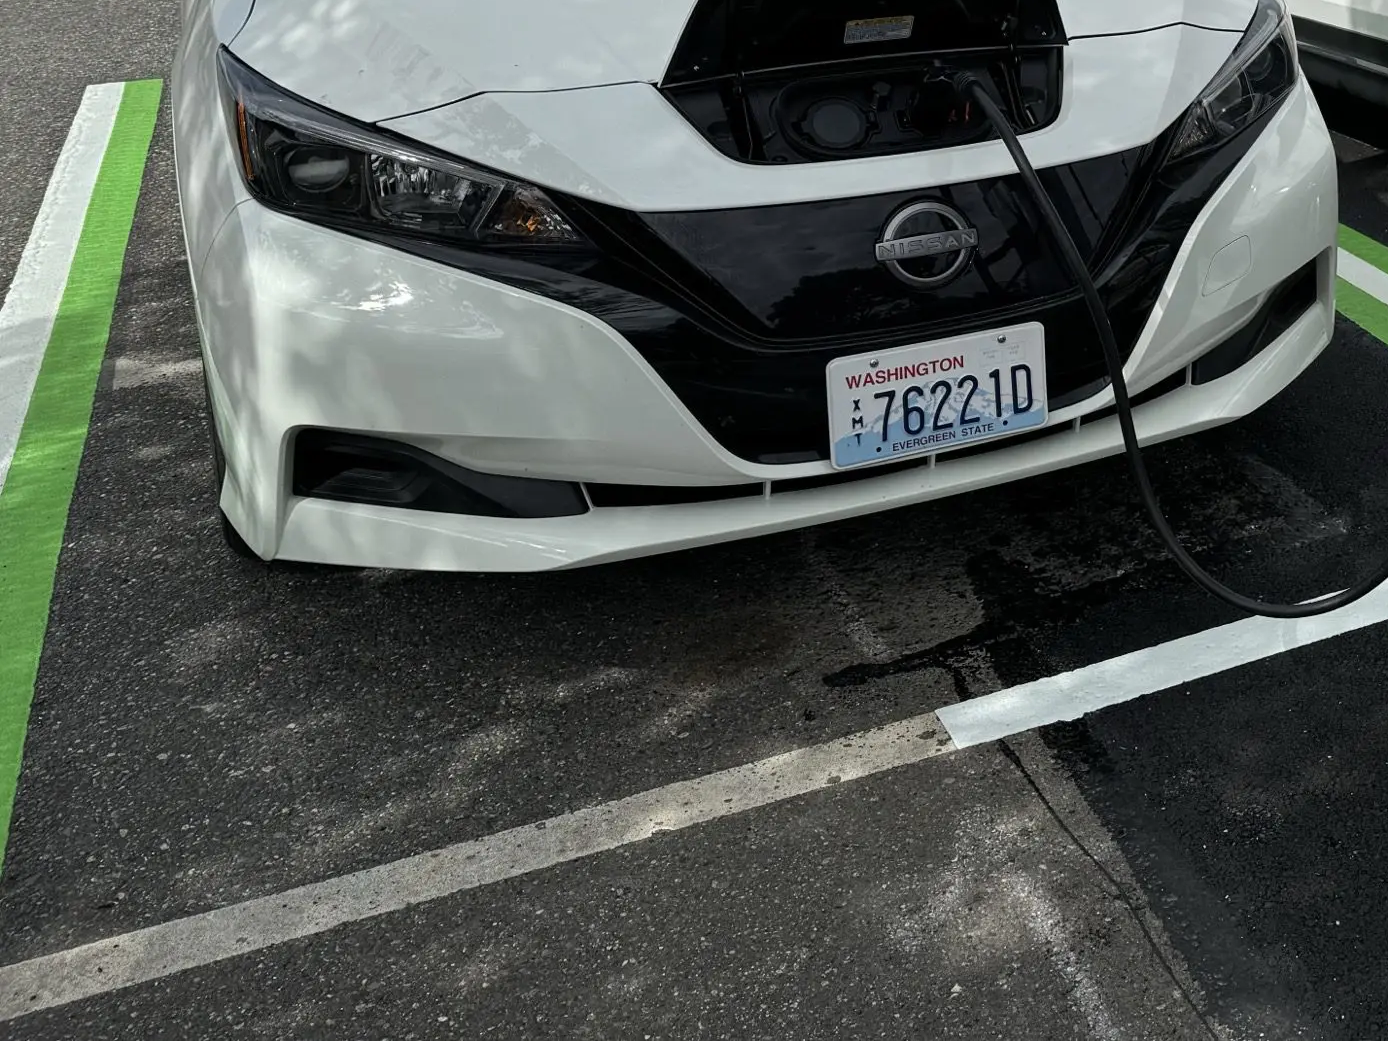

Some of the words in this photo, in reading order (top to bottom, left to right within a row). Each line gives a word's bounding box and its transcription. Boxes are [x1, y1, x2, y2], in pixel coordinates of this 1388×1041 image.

[879, 233, 975, 257] NISSAN
[845, 356, 964, 389] WASHINGTON
[873, 364, 1034, 442] 76221D
[892, 430, 956, 452] EVERGREEN
[961, 423, 994, 437] STATE
